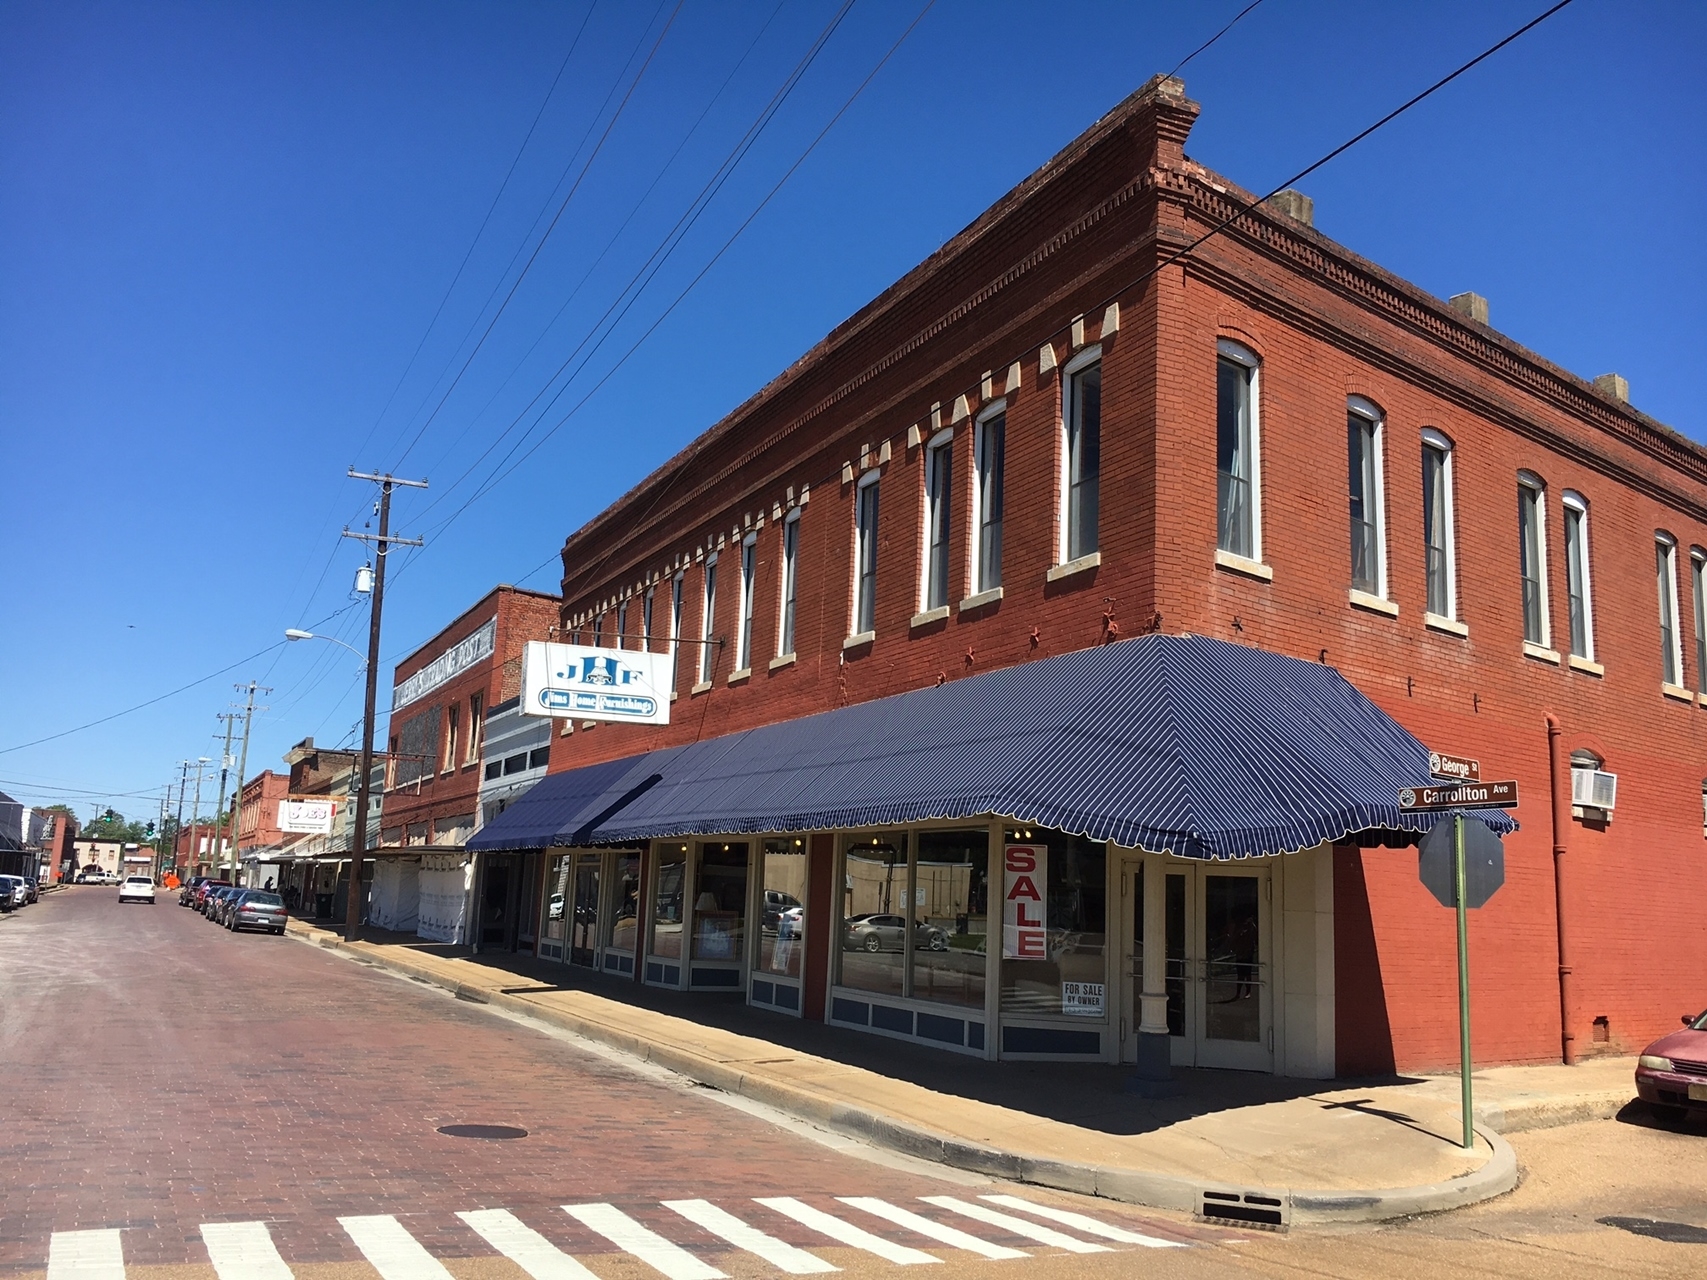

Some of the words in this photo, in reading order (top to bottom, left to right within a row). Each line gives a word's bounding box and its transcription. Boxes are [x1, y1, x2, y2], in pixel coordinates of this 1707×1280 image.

[545, 690, 568, 705] Jims
[570, 692, 597, 709] Home
[599, 694, 652, 714] Furnishings
[1441, 757, 1470, 777] George
[1471, 762, 1478, 772] St
[1423, 788, 1488, 804] Carrollton
[1493, 784, 1509, 794] Ave
[1005, 847, 1045, 957] SALE
[1065, 983, 1080, 995] FOR
[1083, 984, 1102, 996] SALE
[1067, 995, 1076, 1004] BY
[1077, 996, 1100, 1006] OWNER
